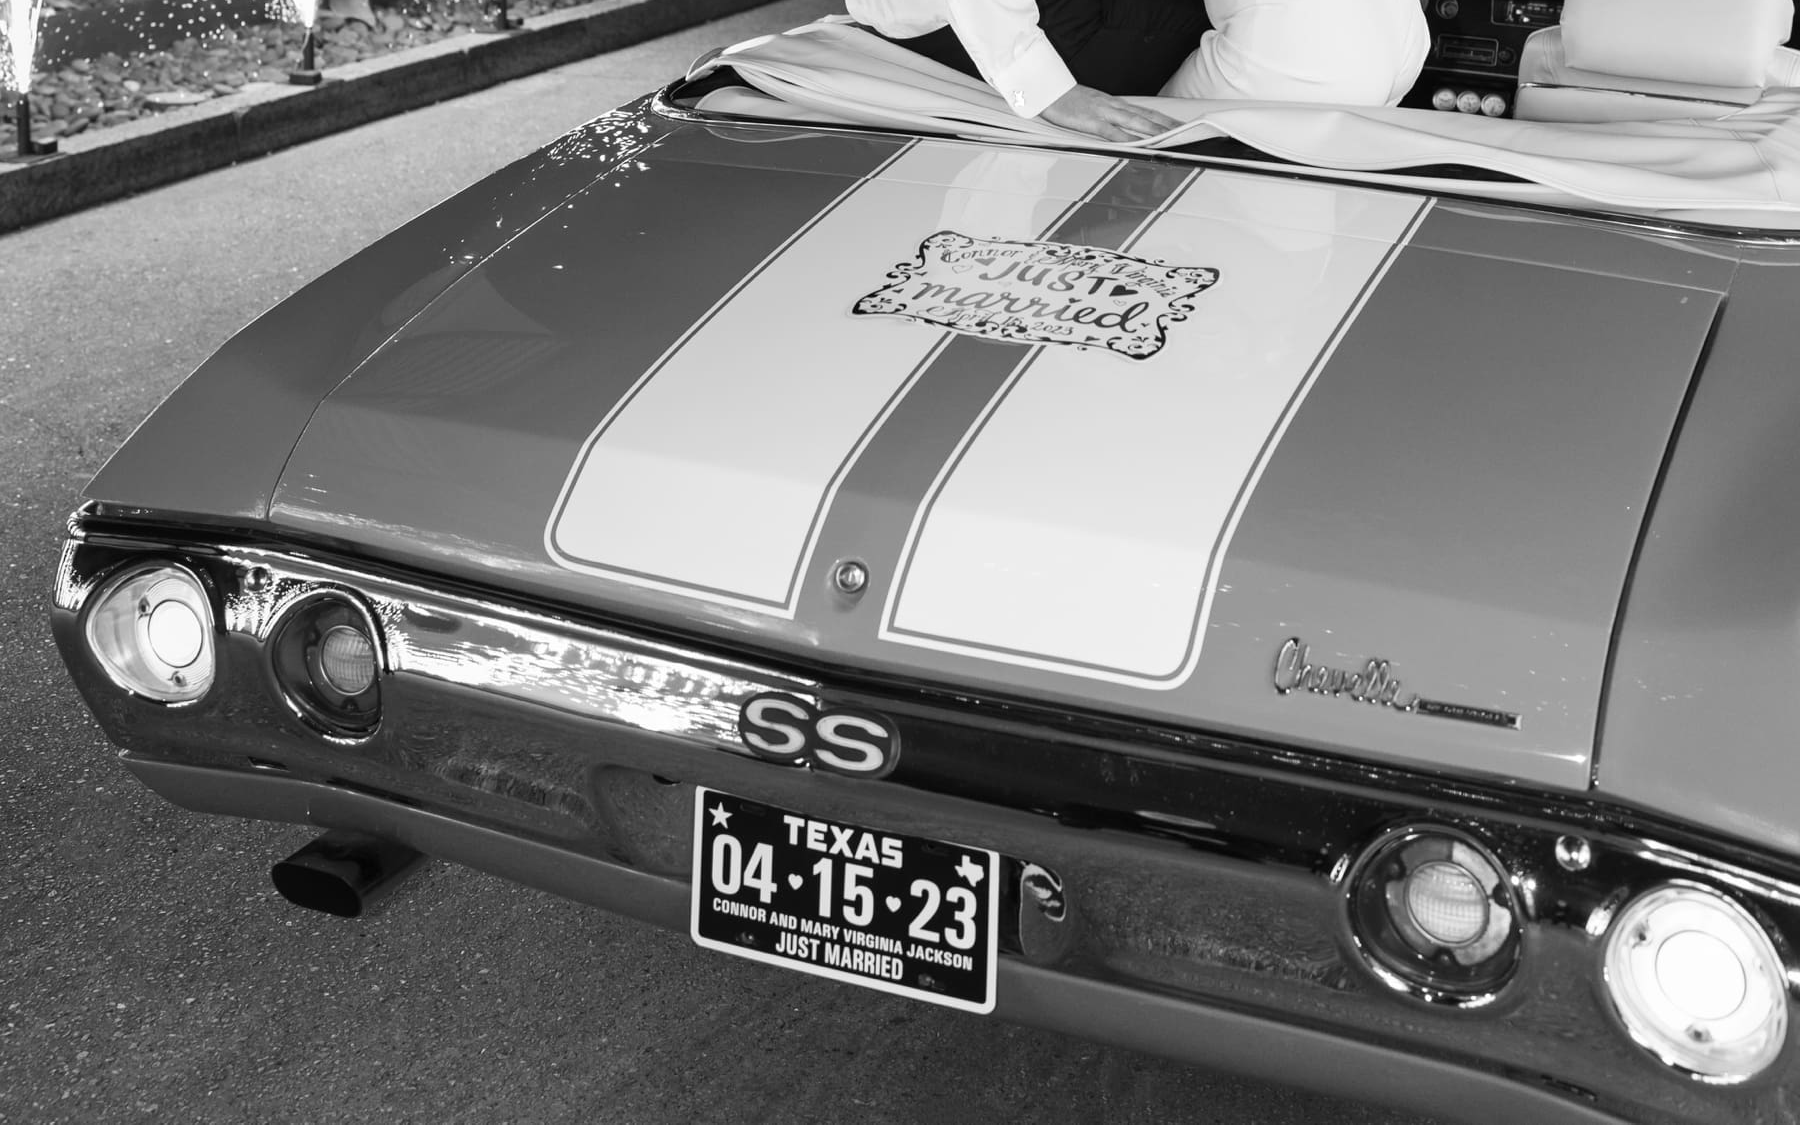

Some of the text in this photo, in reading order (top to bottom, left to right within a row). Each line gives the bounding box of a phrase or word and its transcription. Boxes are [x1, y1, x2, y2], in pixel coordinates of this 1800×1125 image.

[940, 249, 1022, 263] Connor
[911, 282, 1149, 333] married
[1032, 320, 1074, 335] 2023
[1275, 637, 1420, 713] Chevelle
[745, 698, 888, 771] SS
[783, 815, 903, 869] TEXAS
[712, 897, 973, 972] CONNOR AND MARY VIRGINIA JACKSON
[775, 931, 904, 981] JUST MARRIED
